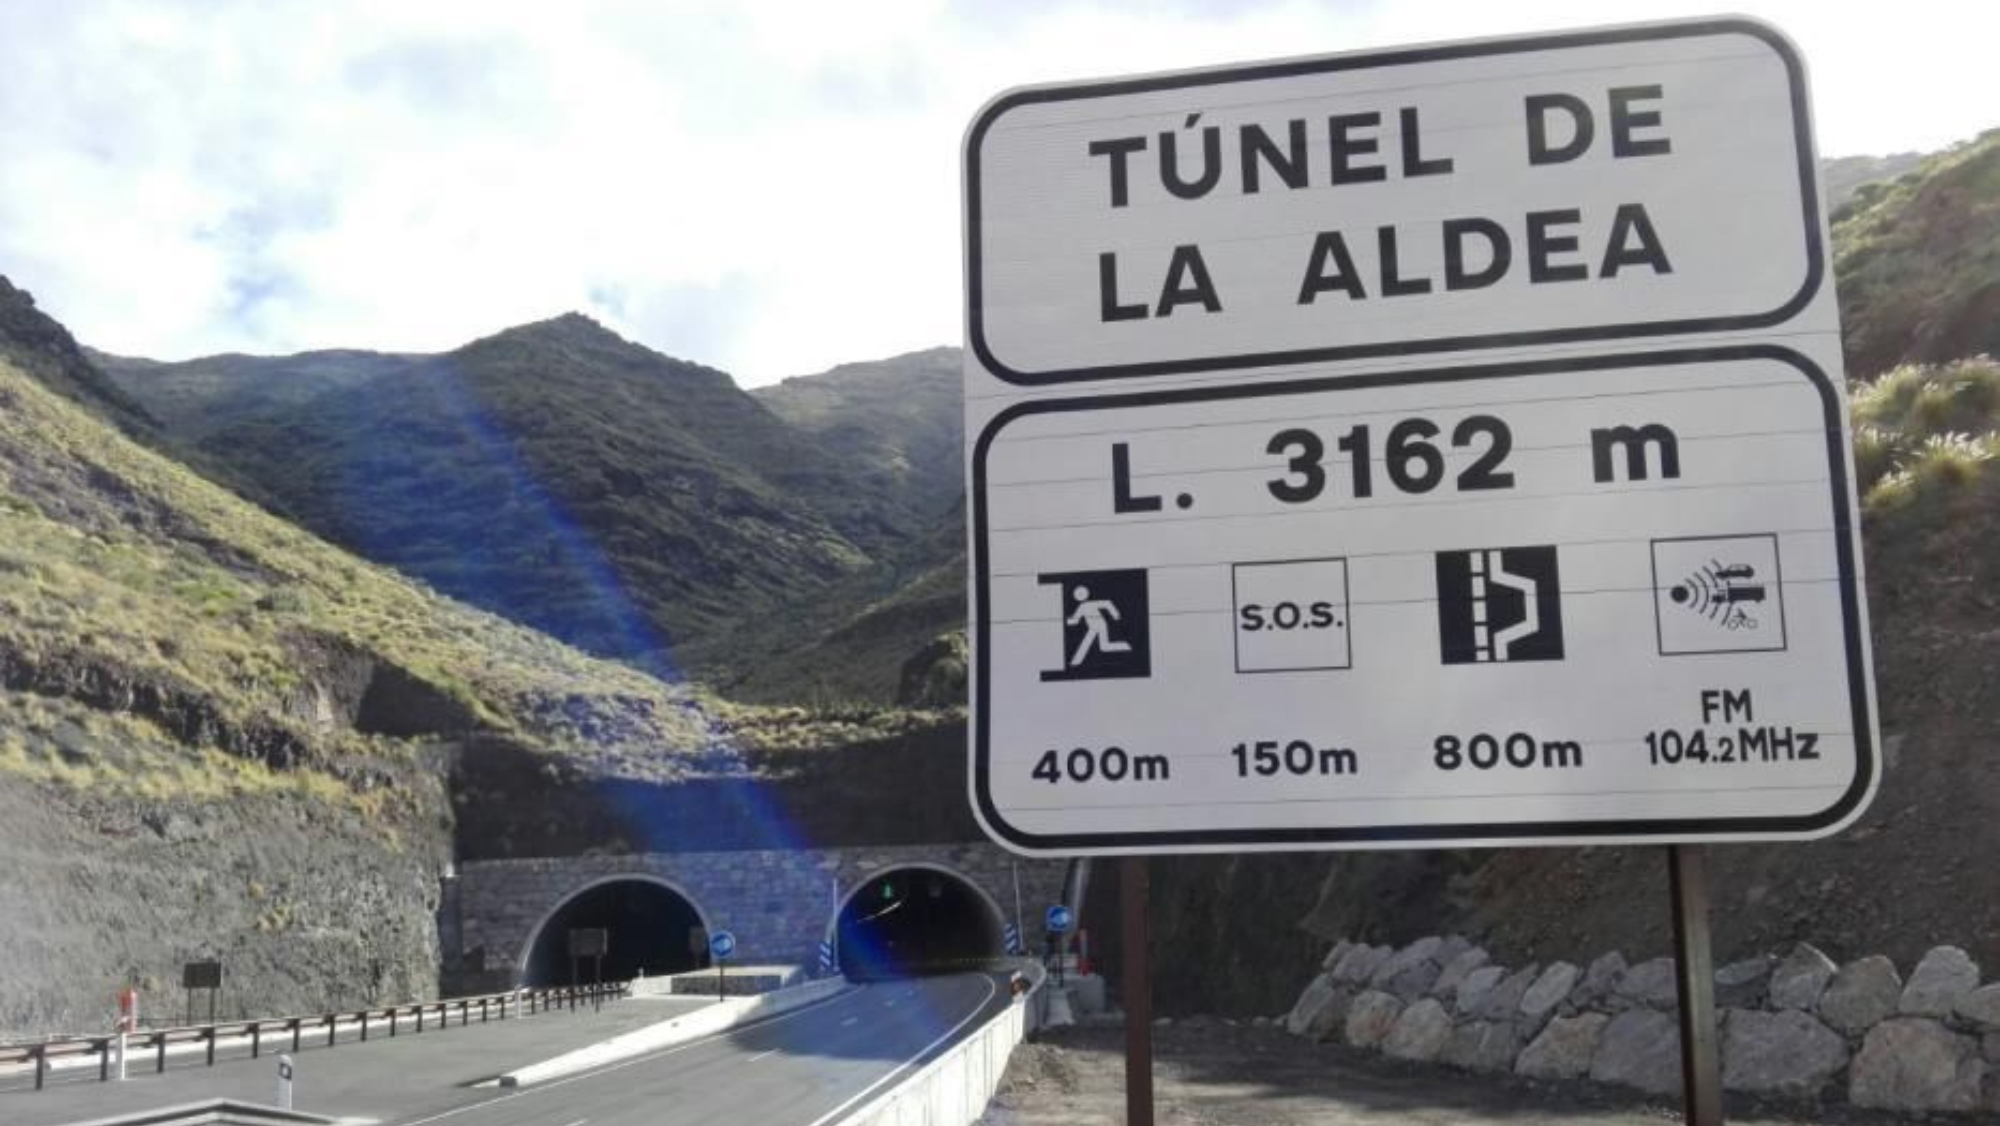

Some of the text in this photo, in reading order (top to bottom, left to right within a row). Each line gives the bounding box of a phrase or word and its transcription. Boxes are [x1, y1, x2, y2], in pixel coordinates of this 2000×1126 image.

[1088, 85, 1671, 208] TÚNEL DE
[1099, 203, 1672, 323] LA ALDEA
[1112, 415, 1681, 514] L. 3162 m
[1240, 601, 1345, 632] S.O.S.
[1700, 688, 1753, 725] FM
[1031, 746, 1170, 784] 400m
[1231, 739, 1358, 778] 150m
[1434, 732, 1583, 771] 800m
